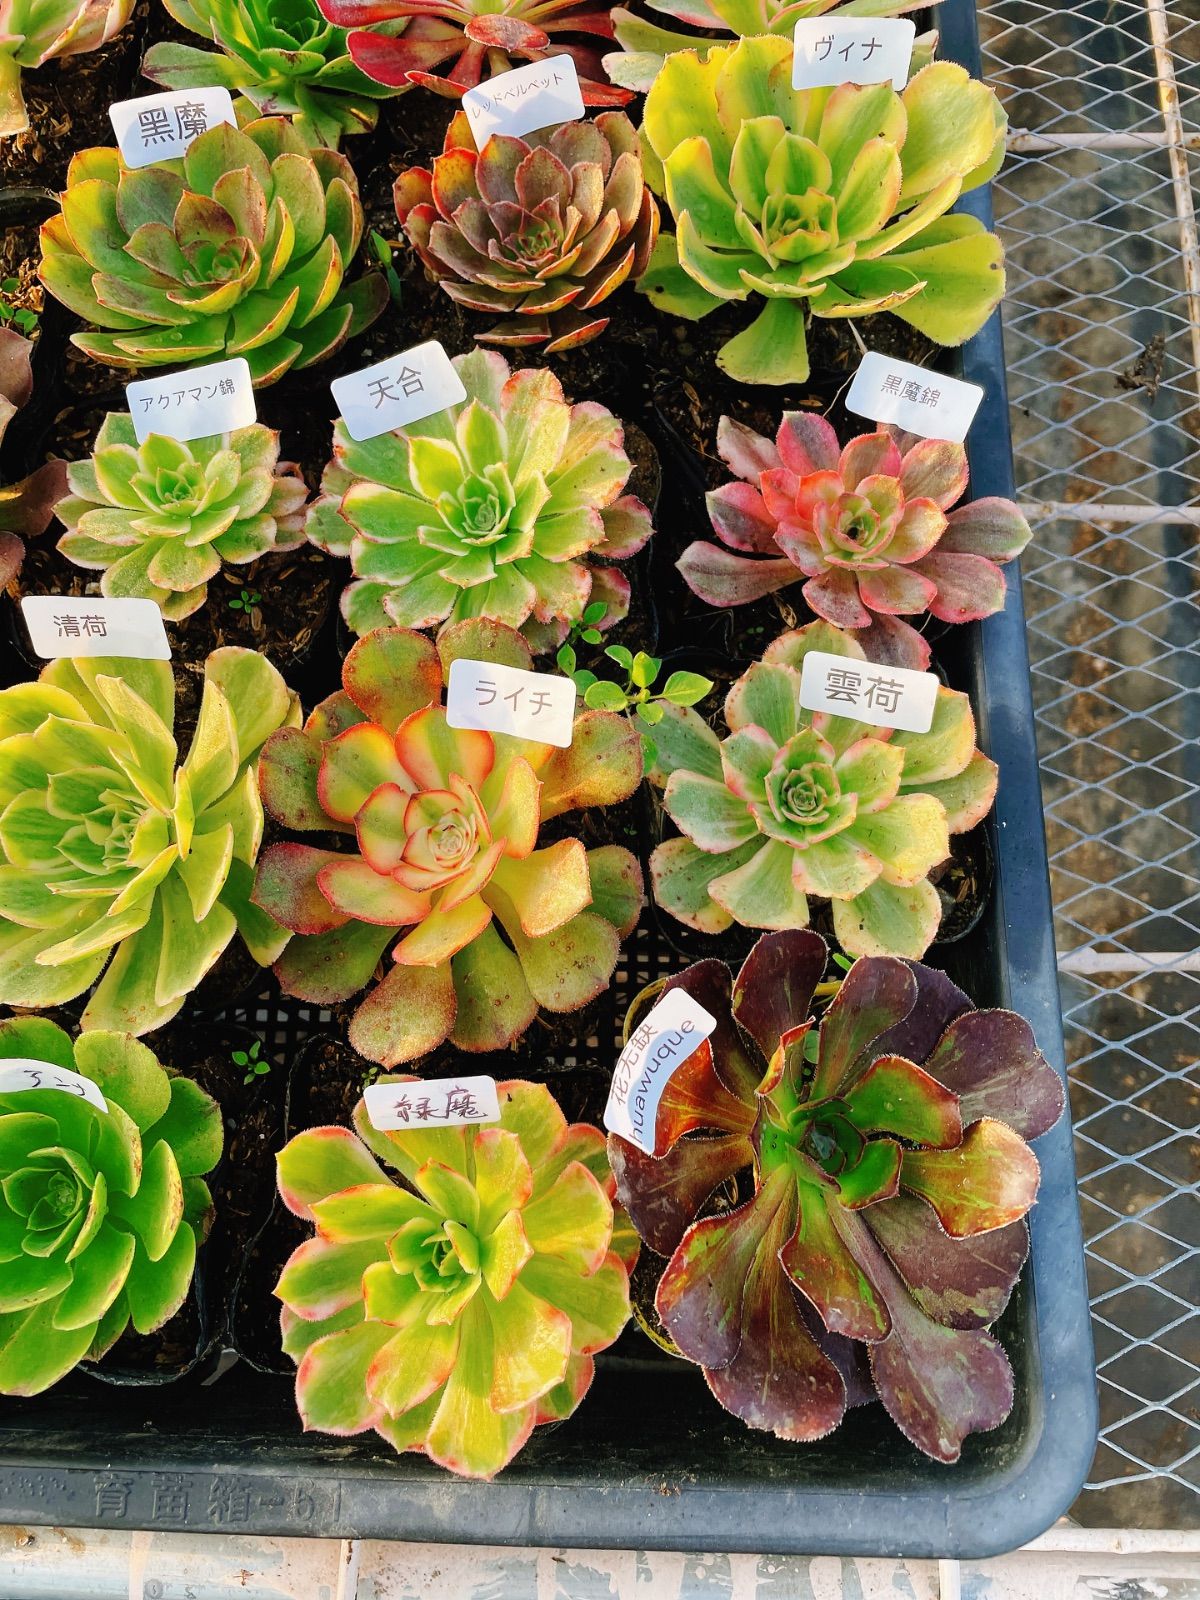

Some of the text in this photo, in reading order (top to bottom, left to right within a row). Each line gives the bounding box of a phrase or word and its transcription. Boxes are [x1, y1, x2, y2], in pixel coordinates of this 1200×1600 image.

[814, 34, 883, 62] ヴィナ
[472, 72, 564, 119] レッドベルベット
[139, 378, 236, 413] アクアマン錦
[366, 366, 425, 410] 天合
[53, 614, 108, 637] 清荷
[475, 680, 553, 716] ライチ
[824, 667, 905, 713] 雲荷
[628, 1019, 696, 1145] huawuque
